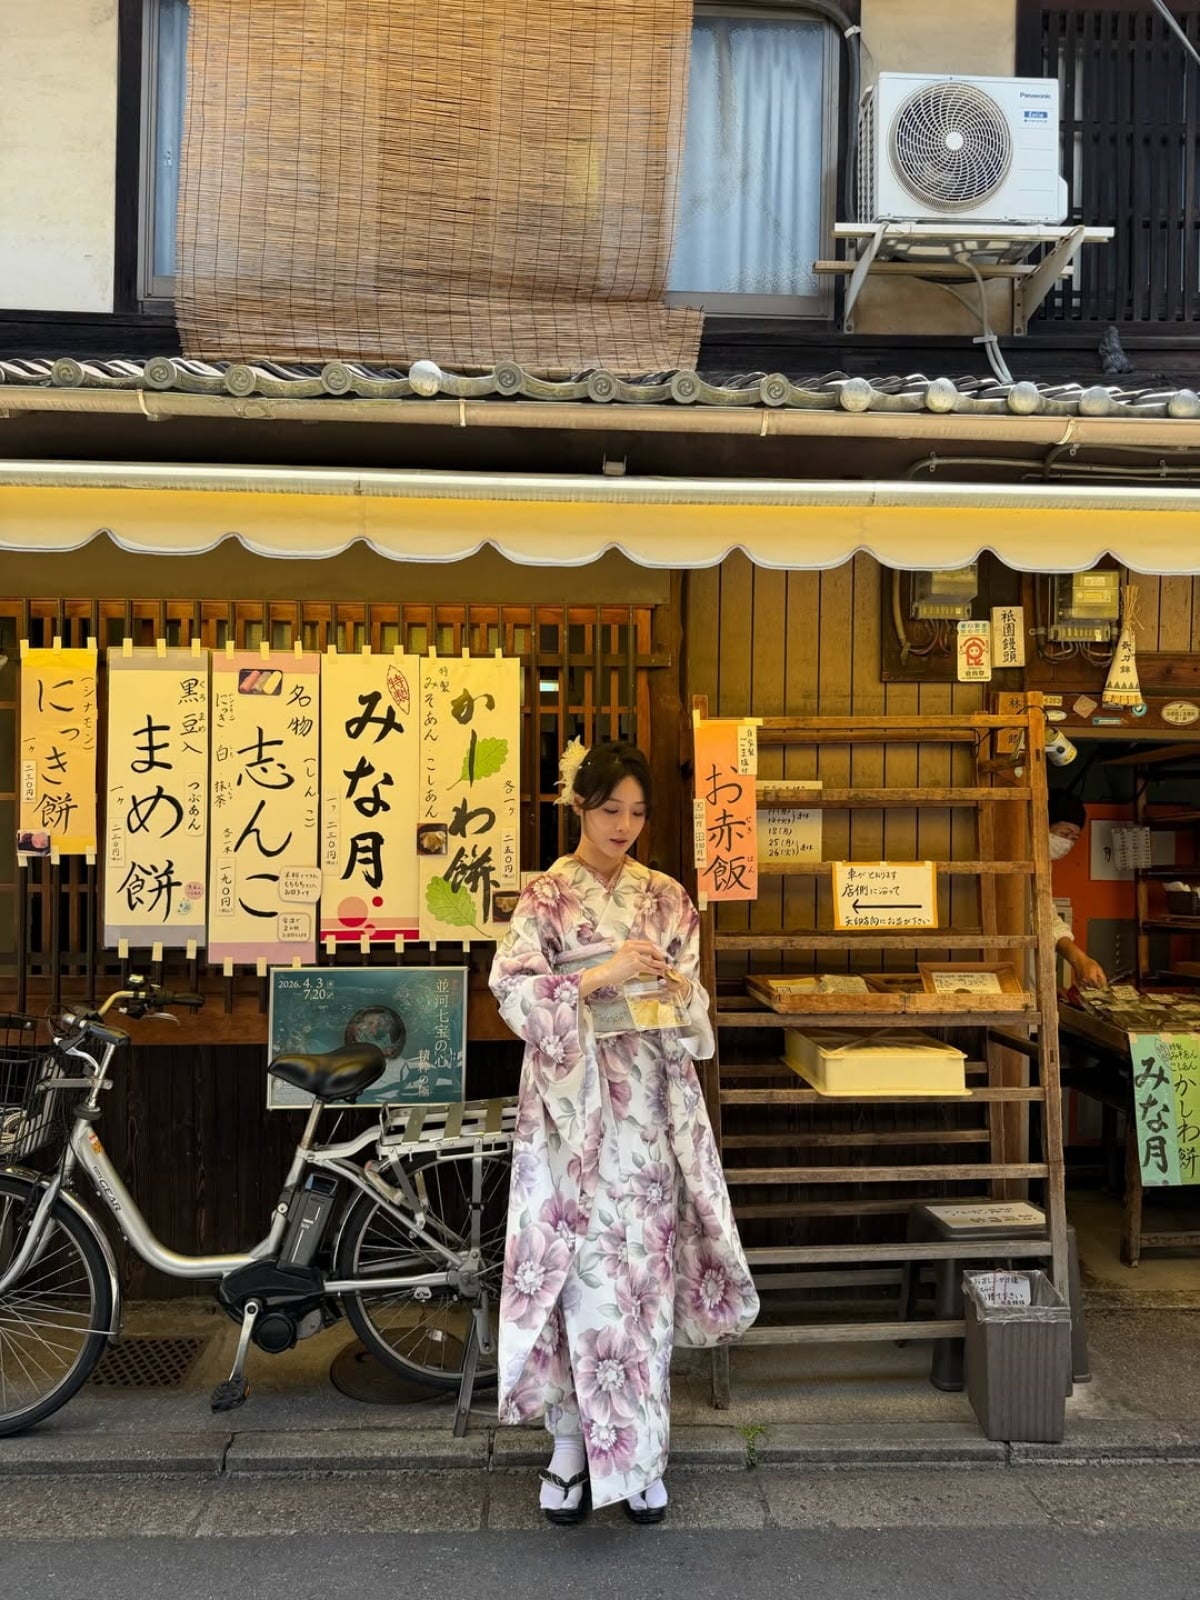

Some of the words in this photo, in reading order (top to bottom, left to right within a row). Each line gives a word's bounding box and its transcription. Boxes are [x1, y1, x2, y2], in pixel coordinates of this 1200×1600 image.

[1000, 609, 1017, 663] 祇園饅頭
[33, 679, 80, 835] にっき餅
[178, 678, 203, 754] 黒豆入
[286, 684, 313, 737] 名物
[117, 714, 184, 923] まめ餅
[187, 781, 201, 831] つぶあん
[234, 726, 295, 918] 志んこ
[340, 690, 405, 890] みな月
[702, 763, 751, 891] お赤飯
[847, 867, 897, 881] 車がとおります
[1134, 1056, 1171, 1174] みな月
[1174, 1074, 1200, 1179] かしわ餅
